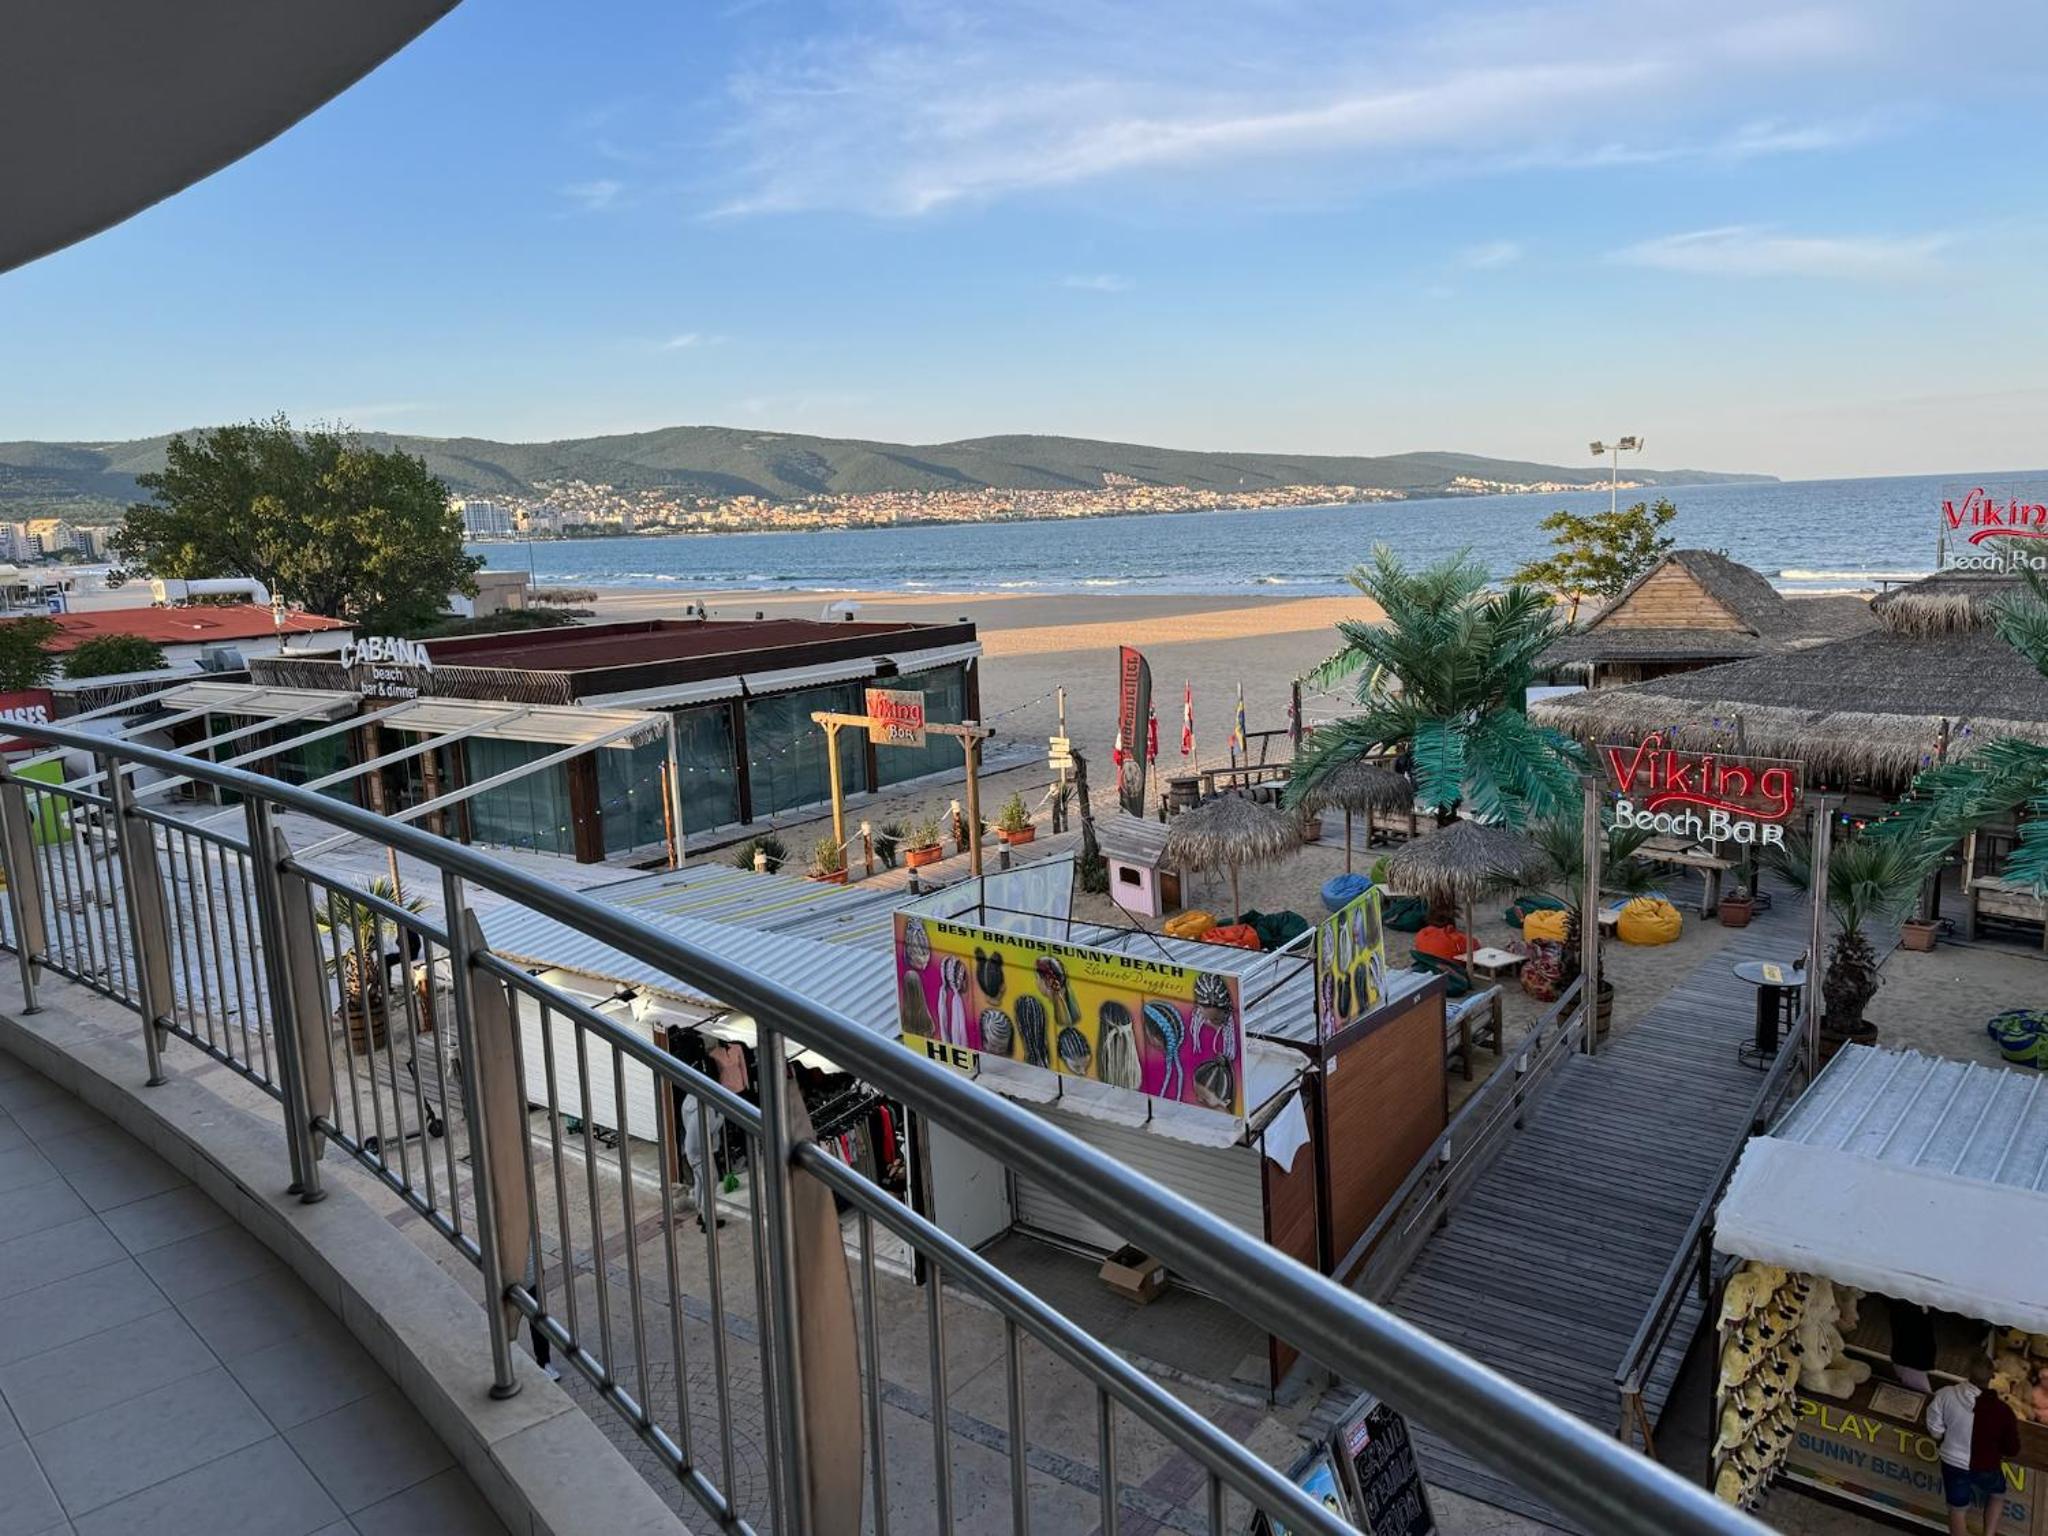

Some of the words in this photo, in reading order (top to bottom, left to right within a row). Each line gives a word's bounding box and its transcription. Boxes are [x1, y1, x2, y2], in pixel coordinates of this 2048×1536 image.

[1942, 487, 2048, 545] Vikin
[1936, 550, 2005, 575] Beach
[2006, 550, 2048, 575] Ba
[341, 636, 432, 673] CABANA
[373, 666, 403, 680] beach
[361, 682, 376, 695] bar
[378, 681, 385, 696] &
[387, 683, 418, 698] dinner
[1608, 732, 1796, 820] Viking
[1607, 799, 1704, 843] Beach
[937, 922, 977, 939] BEST
[983, 931, 1047, 952] BRAIDS
[1052, 944, 1114, 964] SUNNY
[1120, 956, 1184, 978] BEACH
[926, 1041, 980, 1070] HE
[1797, 1431, 1867, 1468] SUNNY
[1871, 1456, 1942, 1496] BEACH
[1893, 1427, 2027, 1492] TON
